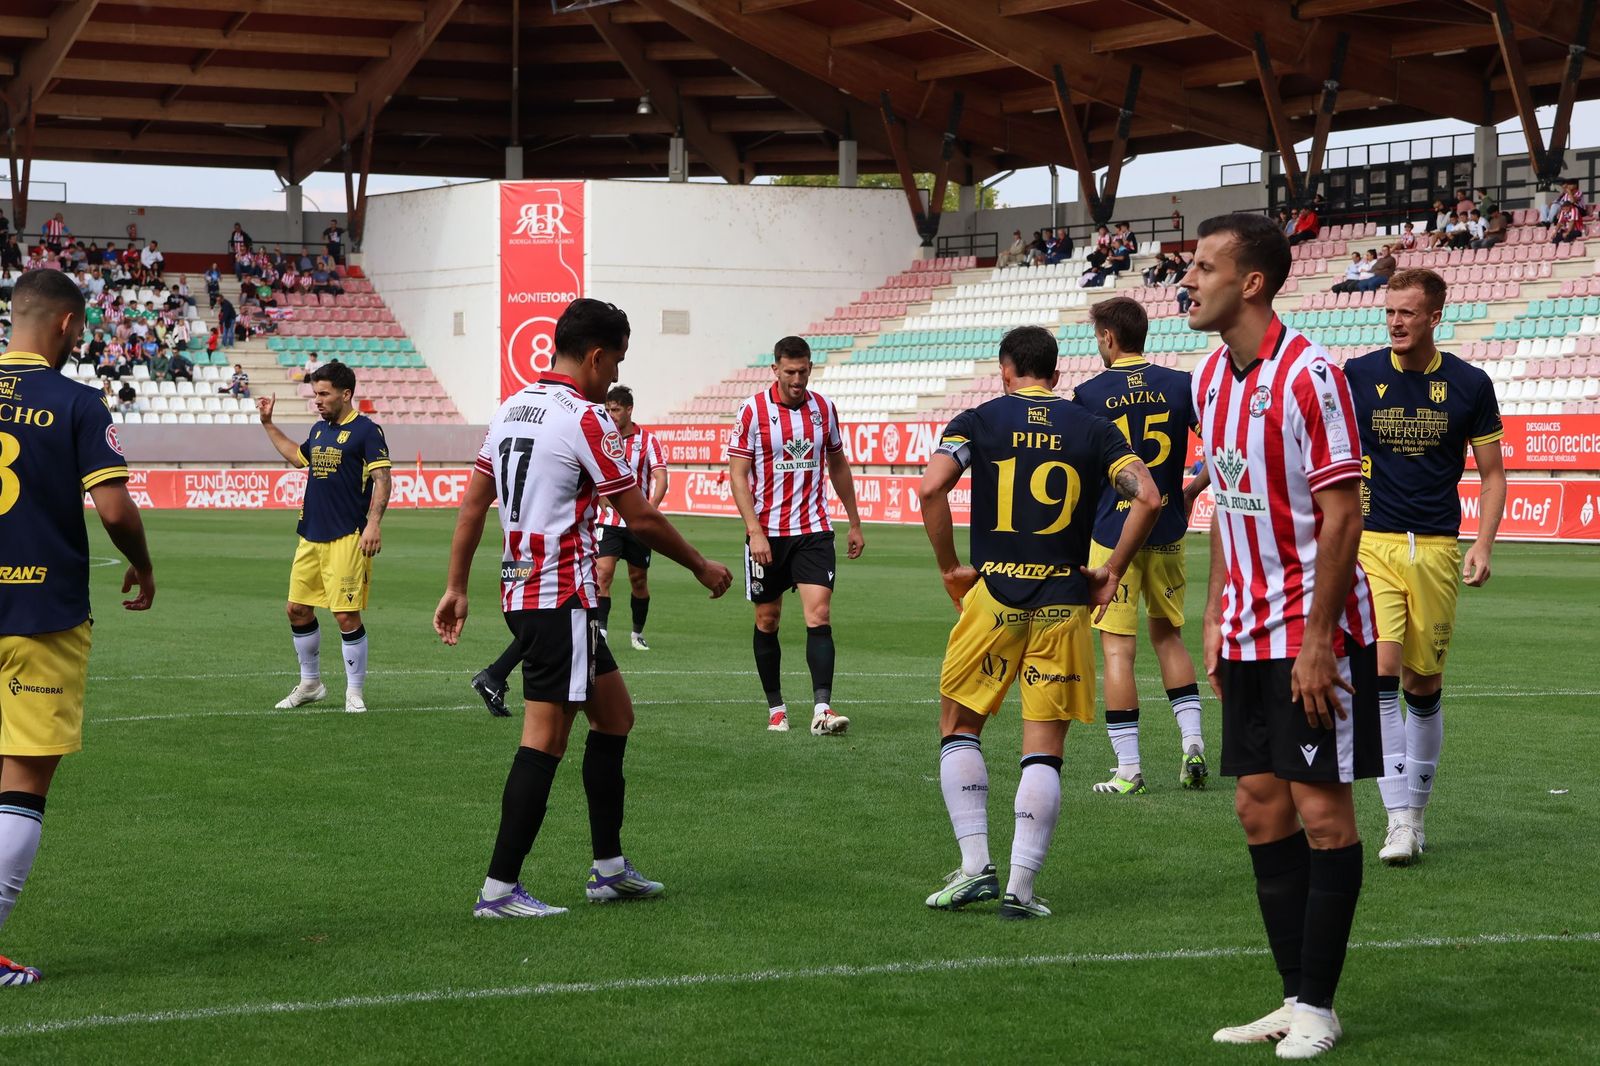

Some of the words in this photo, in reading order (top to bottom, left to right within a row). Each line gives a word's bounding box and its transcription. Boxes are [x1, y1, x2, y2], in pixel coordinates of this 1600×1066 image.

[508, 292, 577, 304] MONTETORO
[1105, 391, 1167, 409] GAIZKA
[1526, 422, 1561, 431] DESGUACES
[1012, 432, 1062, 451] PIPE
[673, 446, 685, 460] 675
[699, 446, 710, 460] 110
[185, 472, 269, 489] FUNDACIÓN
[499, 437, 535, 522] 17
[990, 457, 1081, 535] 19
[1231, 497, 1265, 511] RURAL
[1512, 498, 1552, 527] Chef
[23, 685, 64, 695] INGEOBRAS
